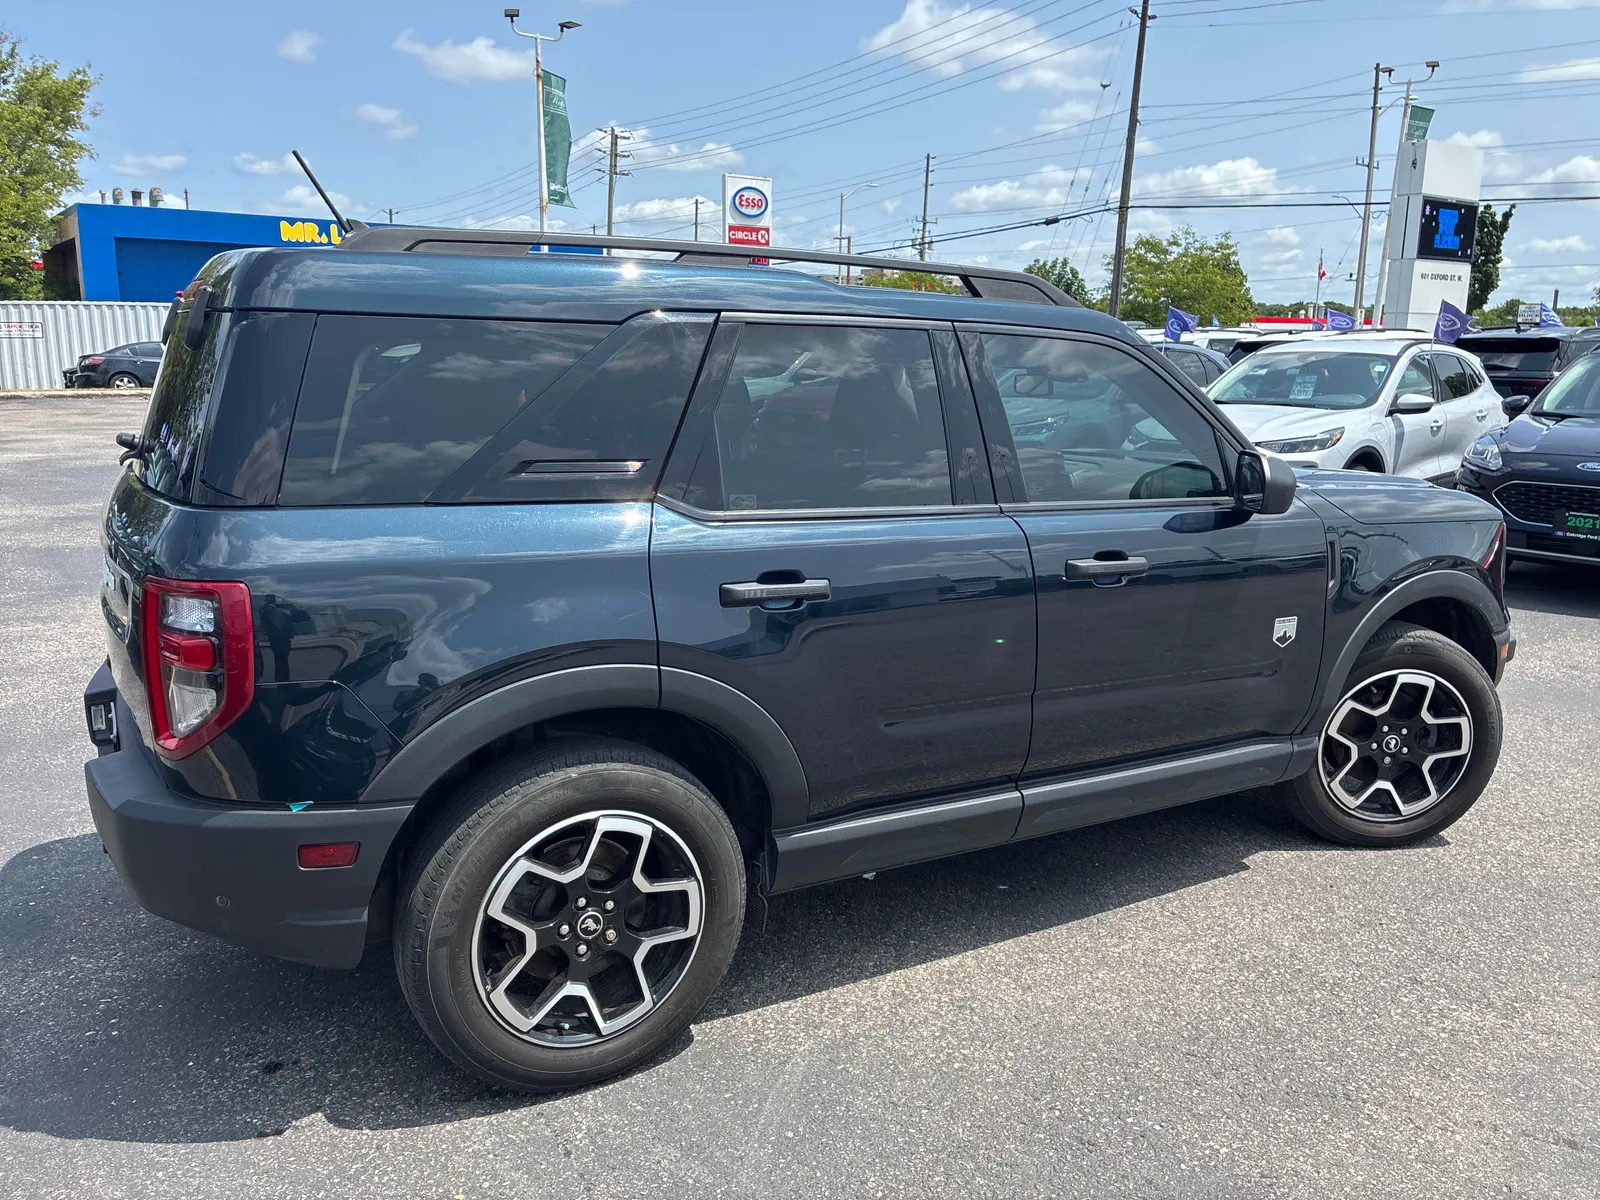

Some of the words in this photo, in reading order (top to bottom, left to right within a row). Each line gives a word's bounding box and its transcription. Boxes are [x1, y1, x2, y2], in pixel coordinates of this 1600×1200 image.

[280, 220, 329, 244] MR.
[729, 230, 757, 241] CIRCLE
[759, 230, 769, 243] K
[1420, 272, 1430, 280] 601
[1430, 273, 1449, 281] OXFORD
[1567, 516, 1600, 529] 2021
